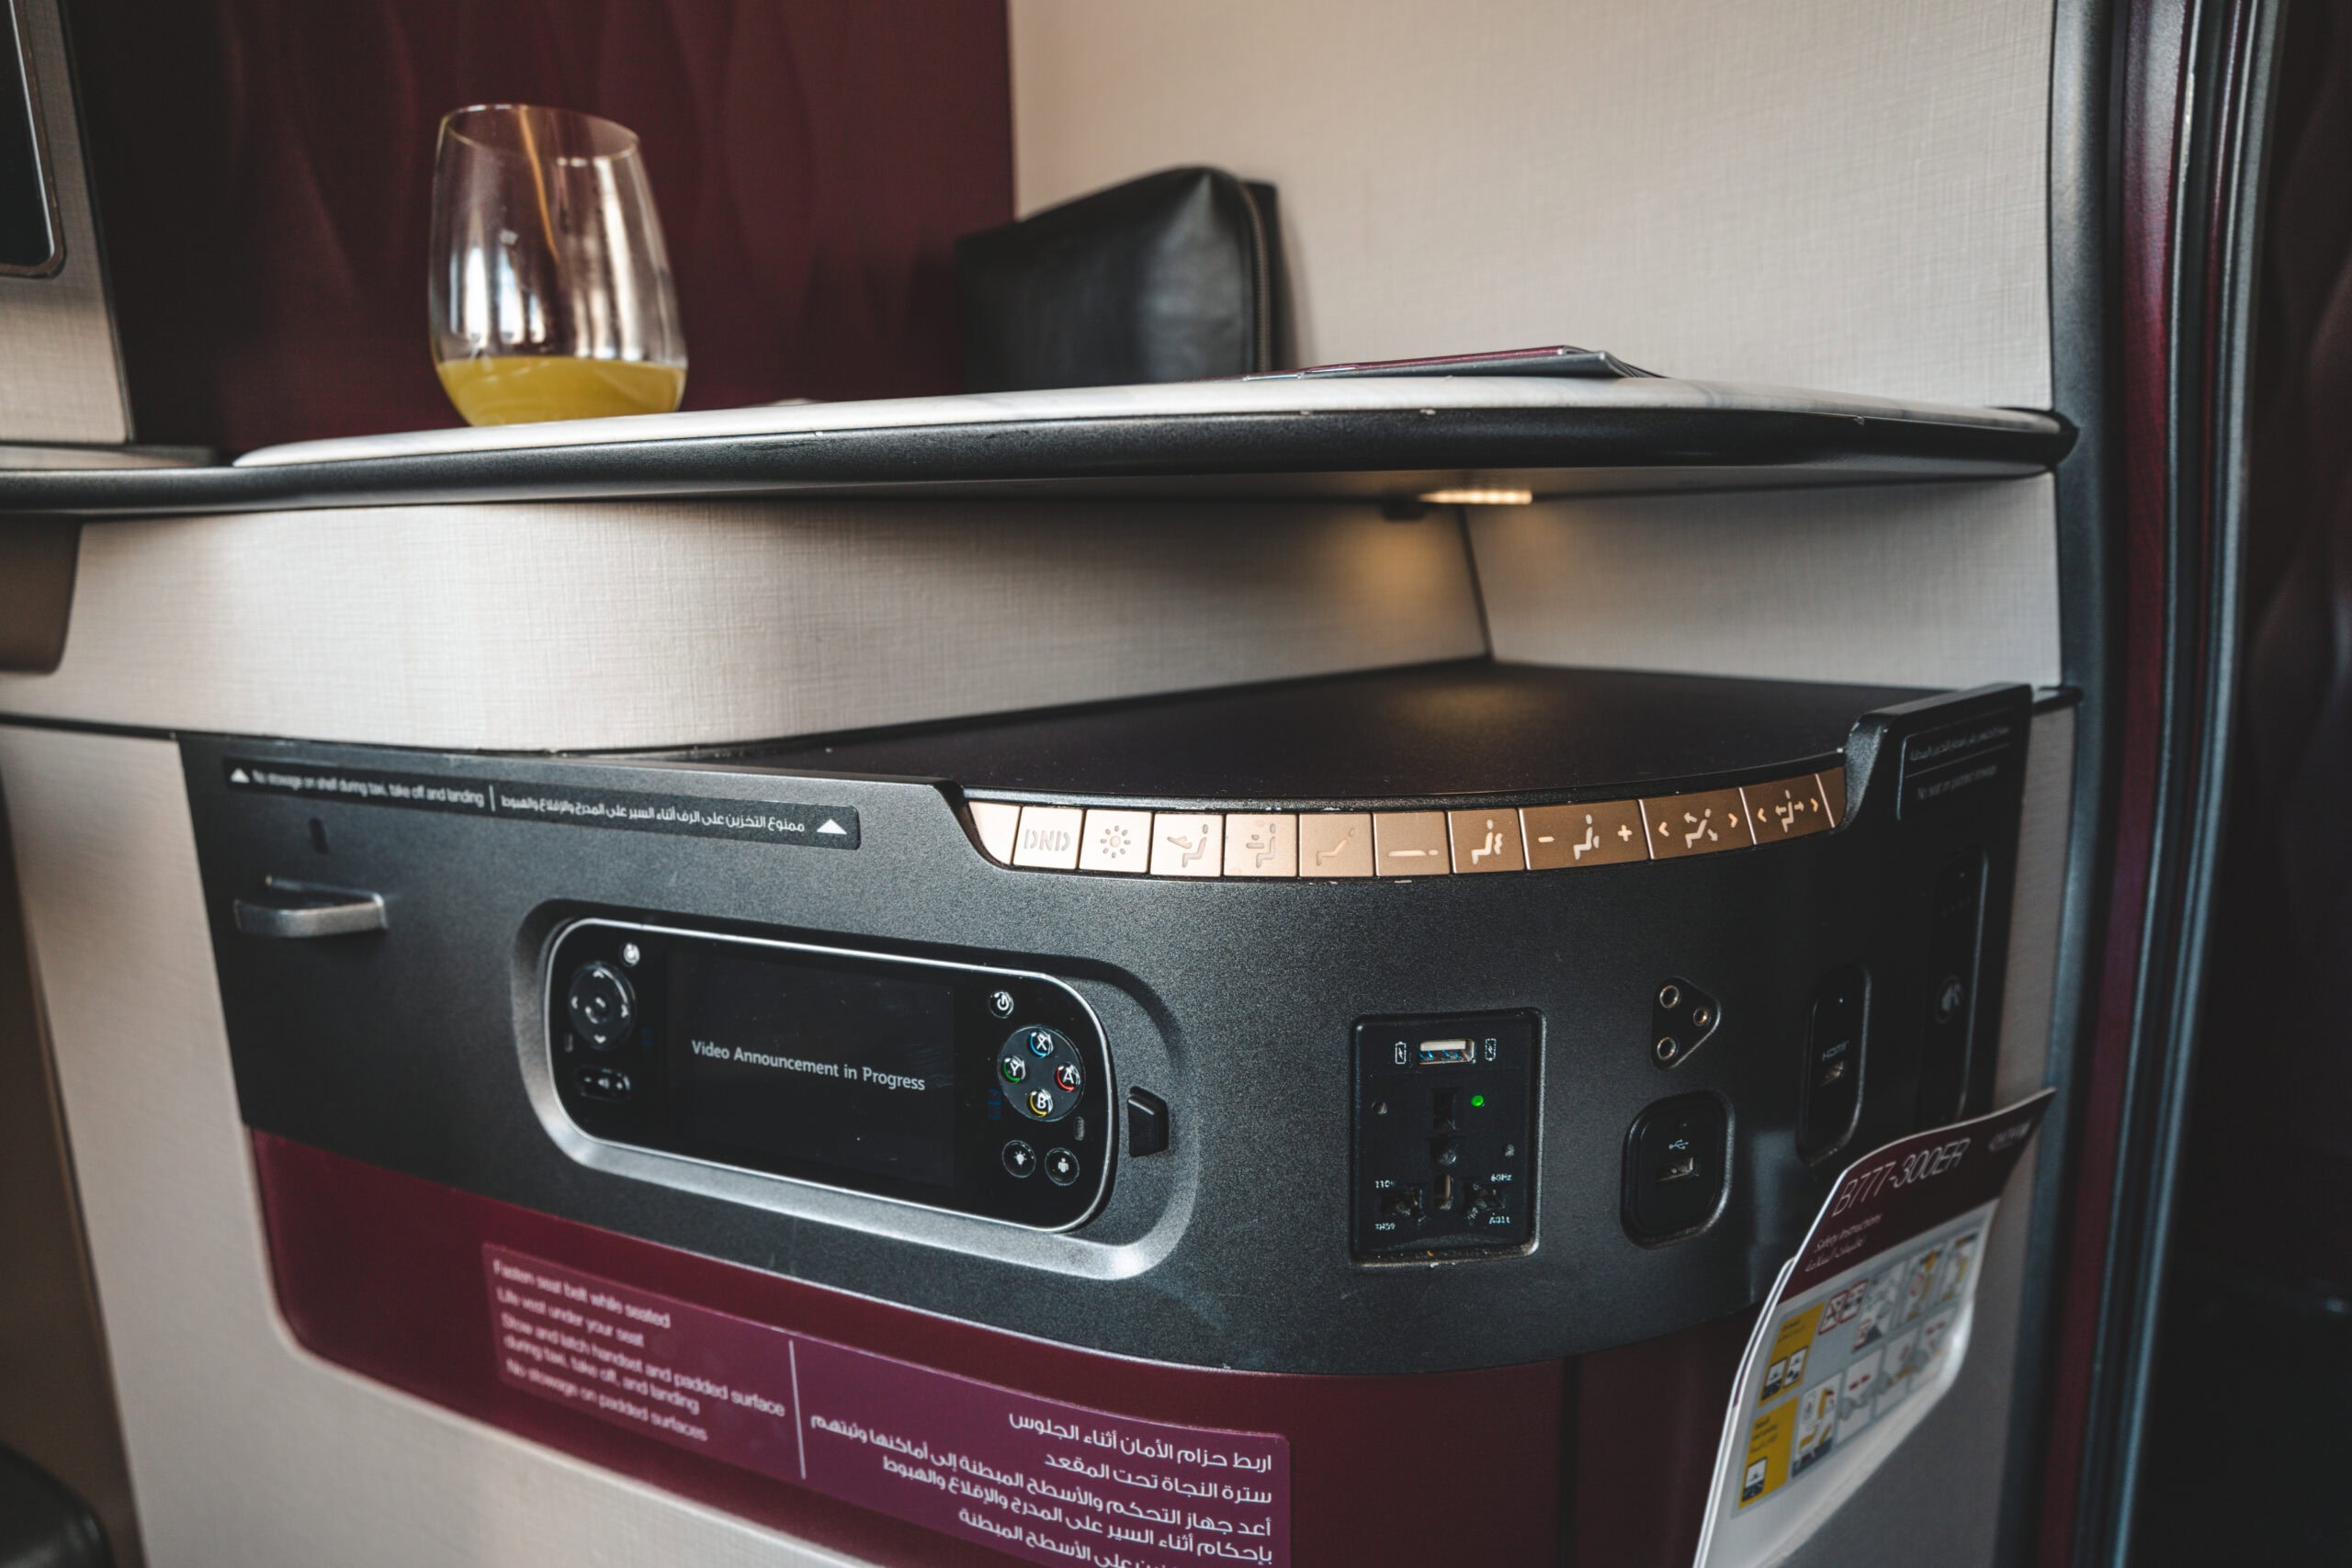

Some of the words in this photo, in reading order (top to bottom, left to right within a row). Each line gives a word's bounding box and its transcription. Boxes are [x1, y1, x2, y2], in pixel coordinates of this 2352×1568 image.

[425, 786, 446, 802] and
[447, 787, 485, 808] landing
[605, 804, 628, 818] على
[628, 807, 655, 820] السير
[656, 806, 676, 821] أثناء
[676, 810, 700, 825] الرف
[702, 811, 725, 827] على
[726, 813, 766, 829] التخزين
[767, 816, 806, 832] ممنوع
[1023, 828, 1070, 852] DND
[1036, 1032, 1047, 1051] X
[691, 1039, 729, 1059] Video
[734, 1046, 840, 1078] Announcement
[843, 1064, 858, 1080] in
[863, 1066, 926, 1090] Progress
[1010, 1059, 1021, 1077] Y
[1062, 1066, 1075, 1084] A
[1036, 1091, 1047, 1109] B
[1831, 1137, 1972, 1219] B777-300ER
[563, 1281, 588, 1303] belt
[589, 1292, 623, 1314] while
[624, 1304, 671, 1329] seated
[548, 1306, 583, 1326] under
[585, 1317, 614, 1337] your
[616, 1327, 644, 1348] seat
[591, 1343, 643, 1373] handset
[645, 1362, 672, 1382] and
[673, 1373, 729, 1400] padded
[730, 1390, 786, 1417] surface
[622, 1377, 649, 1396] and
[649, 1382, 700, 1416] landing
[598, 1393, 649, 1422] padded
[650, 1411, 708, 1442] surfaces
[1009, 1413, 1080, 1441] الجلوس
[869, 1428, 929, 1461] أماكنها
[1083, 1429, 1117, 1450] أثناء
[1120, 1437, 1173, 1461] الأمان
[930, 1452, 957, 1473] إلى
[1044, 1453, 1110, 1480] المقعد
[1177, 1448, 1227, 1468] حزام
[1233, 1451, 1272, 1473] اربط
[882, 1455, 946, 1490] والهبوط
[959, 1455, 1023, 1488] المبطنة
[1113, 1469, 1159, 1489] تحت
[947, 1476, 1009, 1510] والإقلاع
[1026, 1477, 1103, 1509] والأسطح
[1161, 1476, 1218, 1499] النجاة
[1222, 1484, 1272, 1505] سترة
[1011, 1496, 1062, 1524] المدرج
[1106, 1500, 1182, 1526] التحكم
[958, 1506, 1023, 1541] المبطنة
[1065, 1514, 1103, 1534] على
[1185, 1512, 1233, 1534] جهاز
[1237, 1516, 1272, 1537] أعد
[1025, 1531, 1091, 1561] الأسطح
[1107, 1525, 1154, 1546] السير
[1159, 1532, 1194, 1553] أثناء
[1196, 1540, 1273, 1565] بإحكام
